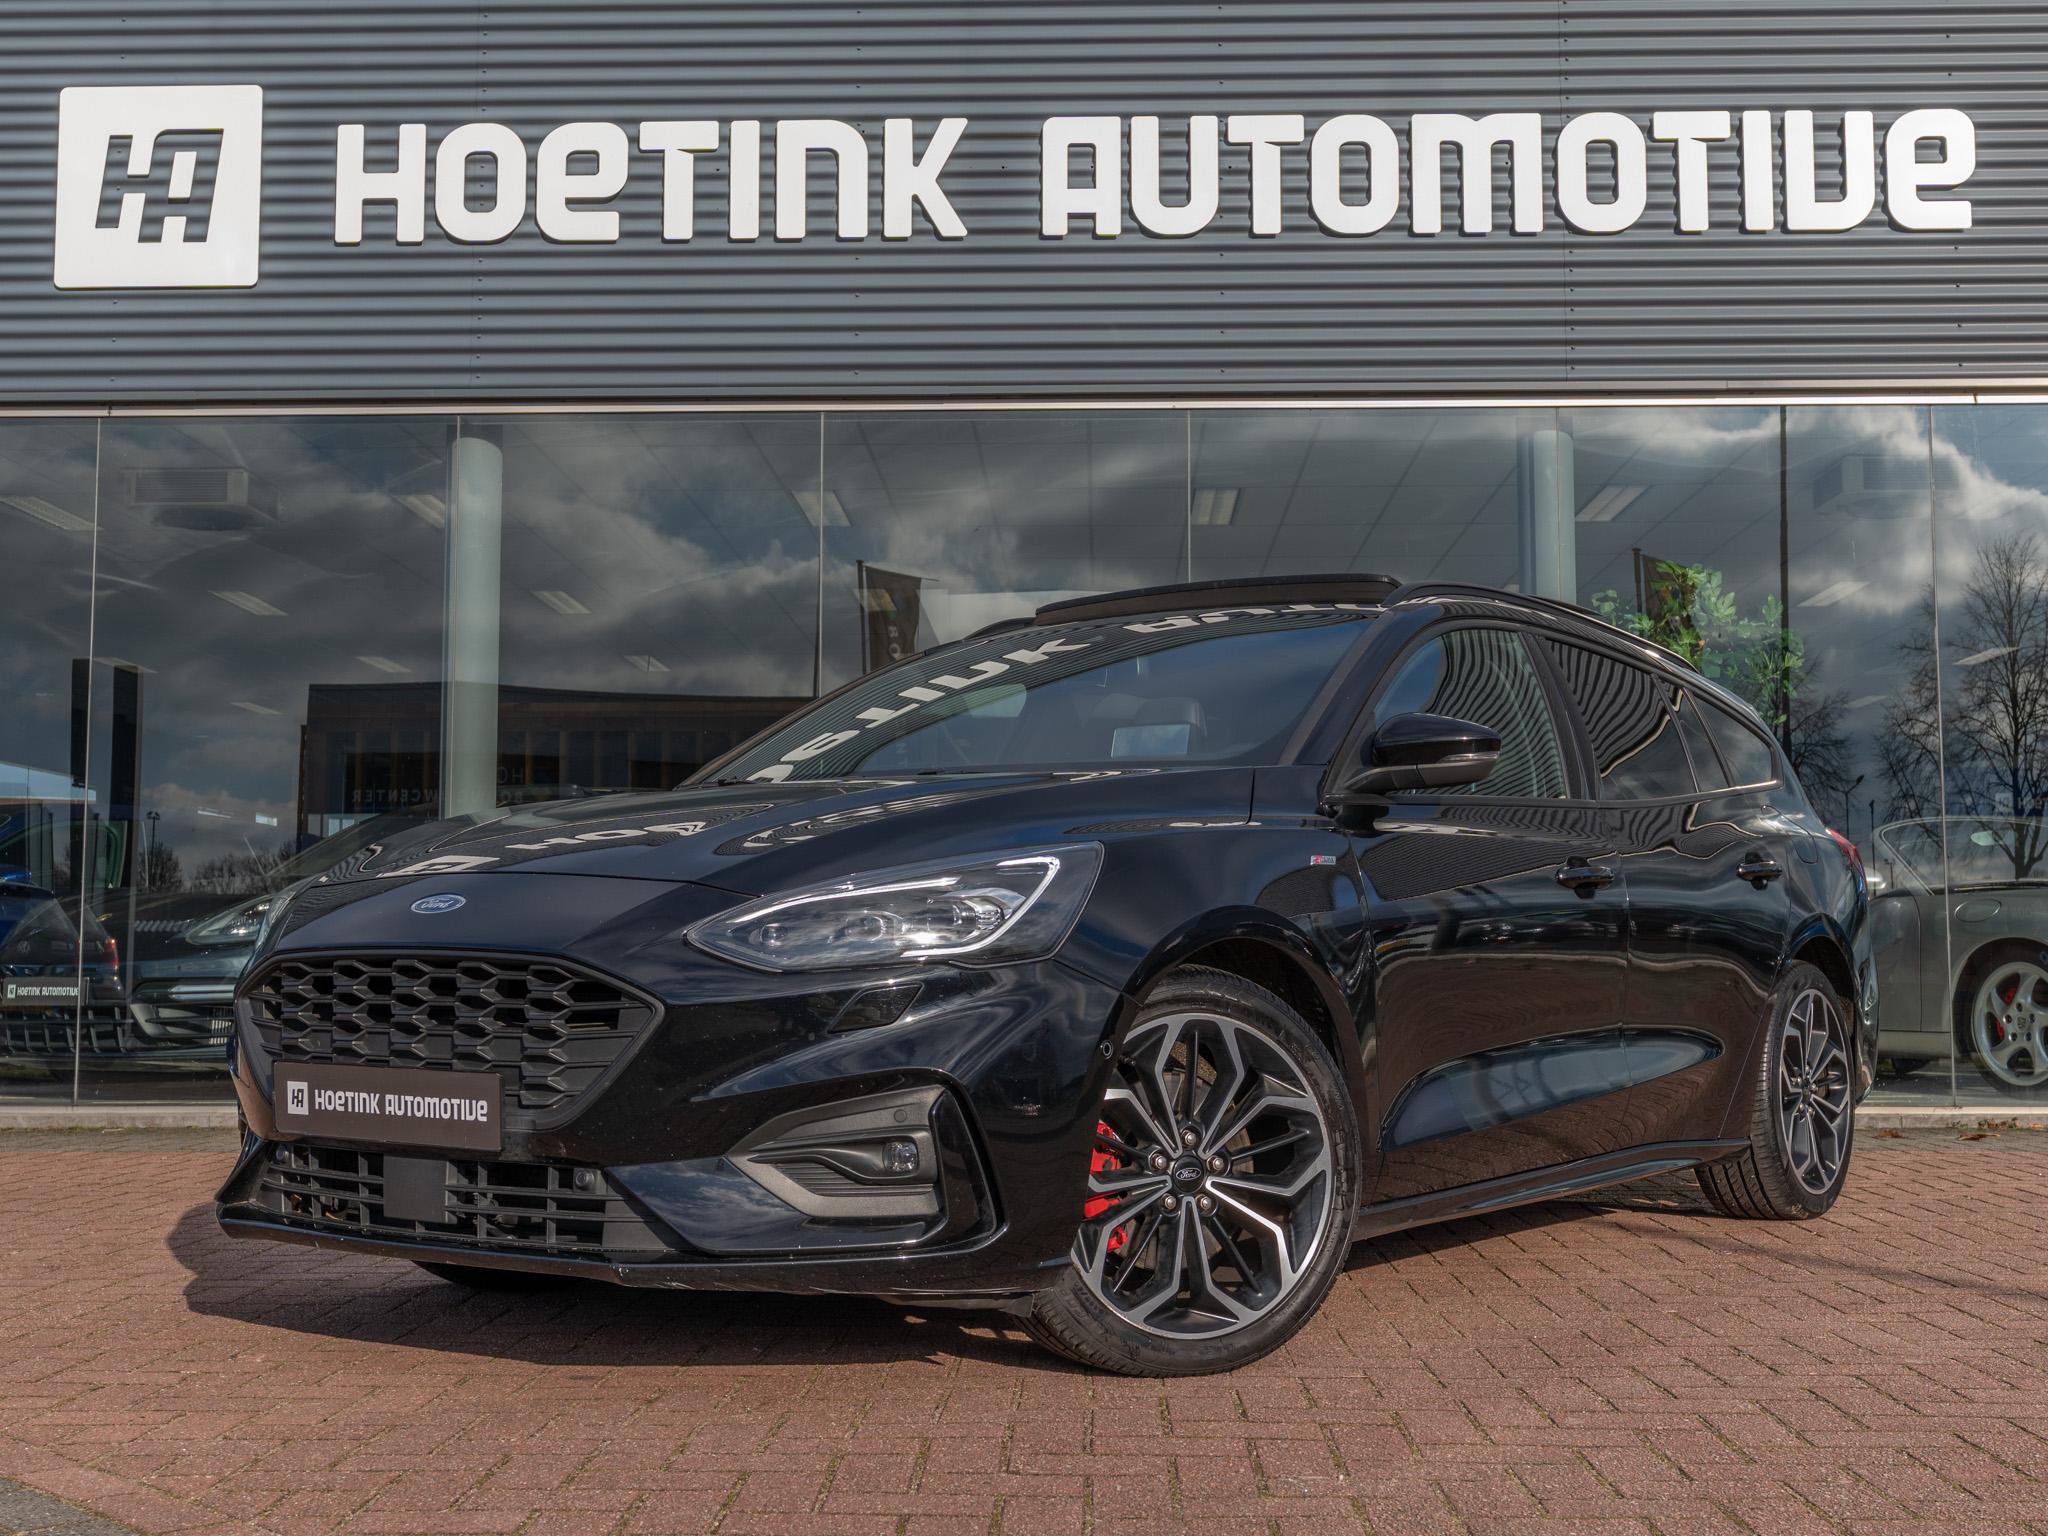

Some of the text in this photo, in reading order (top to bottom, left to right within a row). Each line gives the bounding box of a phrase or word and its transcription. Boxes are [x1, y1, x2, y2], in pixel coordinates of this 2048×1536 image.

[335, 109, 1975, 242] HOETINK AUTOMOTIVE
[315, 1090, 487, 1121] HOETINK AUTOMOTIVE
